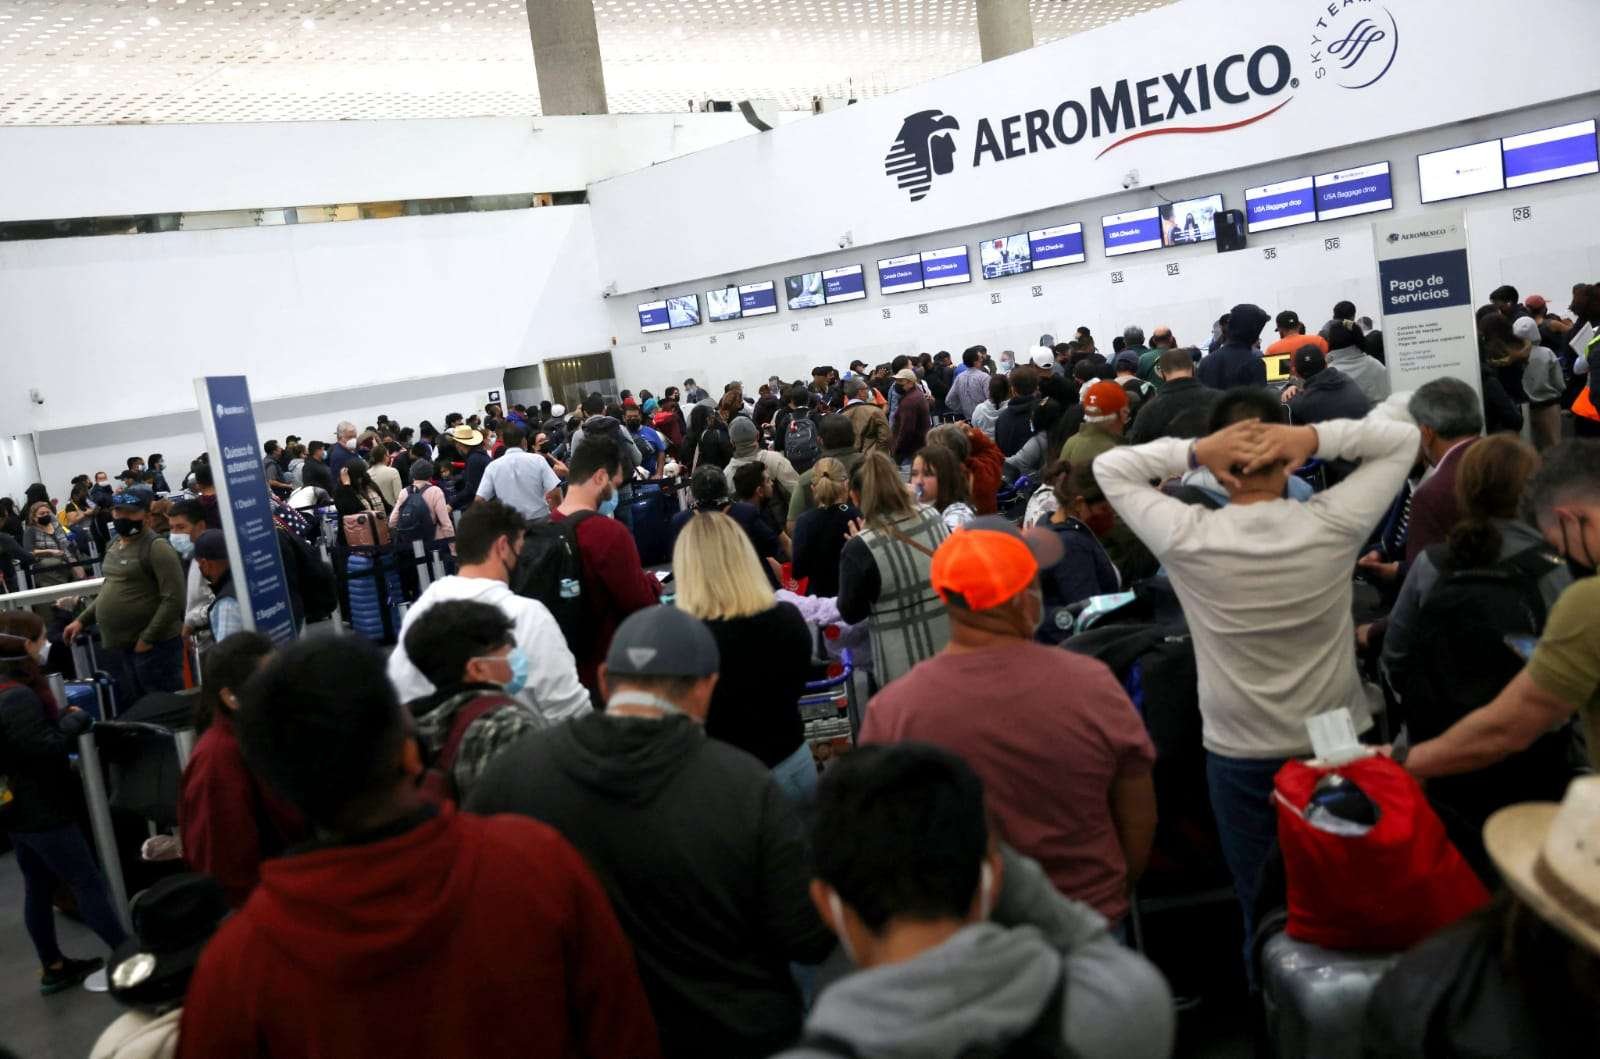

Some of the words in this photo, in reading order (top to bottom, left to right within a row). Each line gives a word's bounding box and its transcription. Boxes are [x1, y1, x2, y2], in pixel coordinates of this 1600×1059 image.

[1310, 0, 1372, 79] SKYTEA
[973, 45, 1291, 167] AEROMEXICO
[1323, 192, 1336, 200] USA
[1337, 189, 1362, 199] Baggage
[1362, 185, 1377, 194] drop
[1253, 205, 1266, 213] USA
[1266, 202, 1289, 211] Baggage
[1289, 199, 1302, 207] drop
[1389, 278, 1424, 291] Pago
[1427, 275, 1444, 287] de
[1391, 287, 1449, 304] servicios
